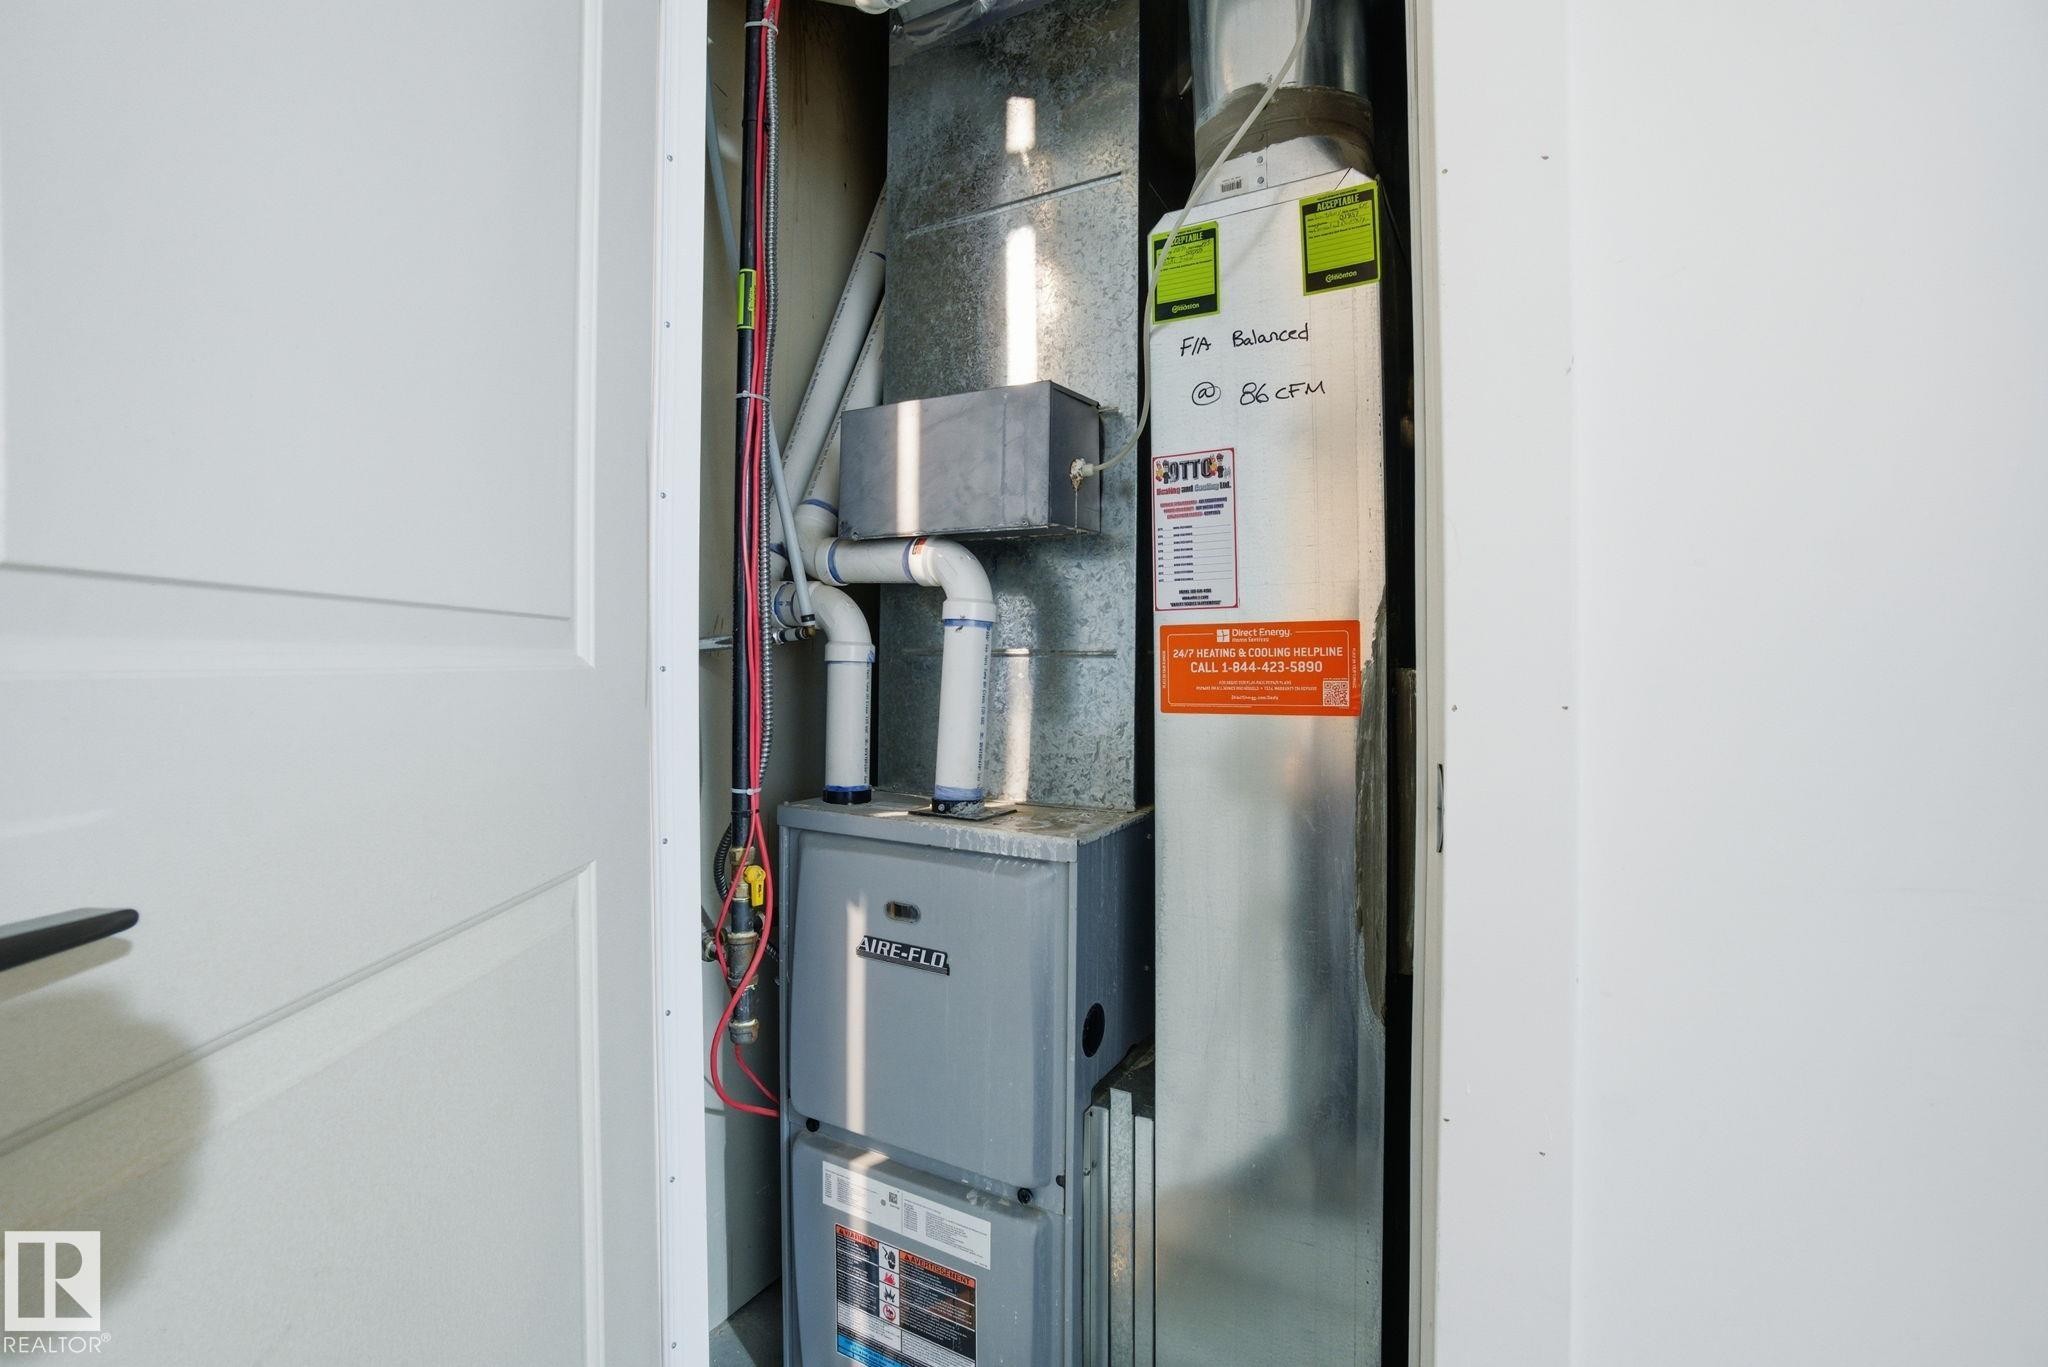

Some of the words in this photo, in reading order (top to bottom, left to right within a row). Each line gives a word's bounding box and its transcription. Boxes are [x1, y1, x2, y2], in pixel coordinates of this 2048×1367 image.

[1316, 193, 1360, 212] ACCEPTABLE
[1171, 231, 1203, 246] CCEPTABLE
[1180, 336, 1212, 357] F/A
[1232, 322, 1309, 348] Balanced
[1191, 381, 1222, 406] @
[1239, 382, 1270, 406] 86
[1275, 380, 1326, 400] CFM
[1181, 485, 1193, 493] and
[1232, 628, 1258, 637] Direct
[1173, 649, 1194, 658] 24/7
[1196, 648, 1236, 658] HEATING
[1239, 648, 1247, 658] &
[1248, 648, 1291, 658] COOLING
[1293, 646, 1343, 657] HELPLINE
[1190, 661, 1218, 673] CALL
[1221, 660, 1323, 673] 1-844-423-5890
[857, 936, 947, 969] AIRE-FLO
